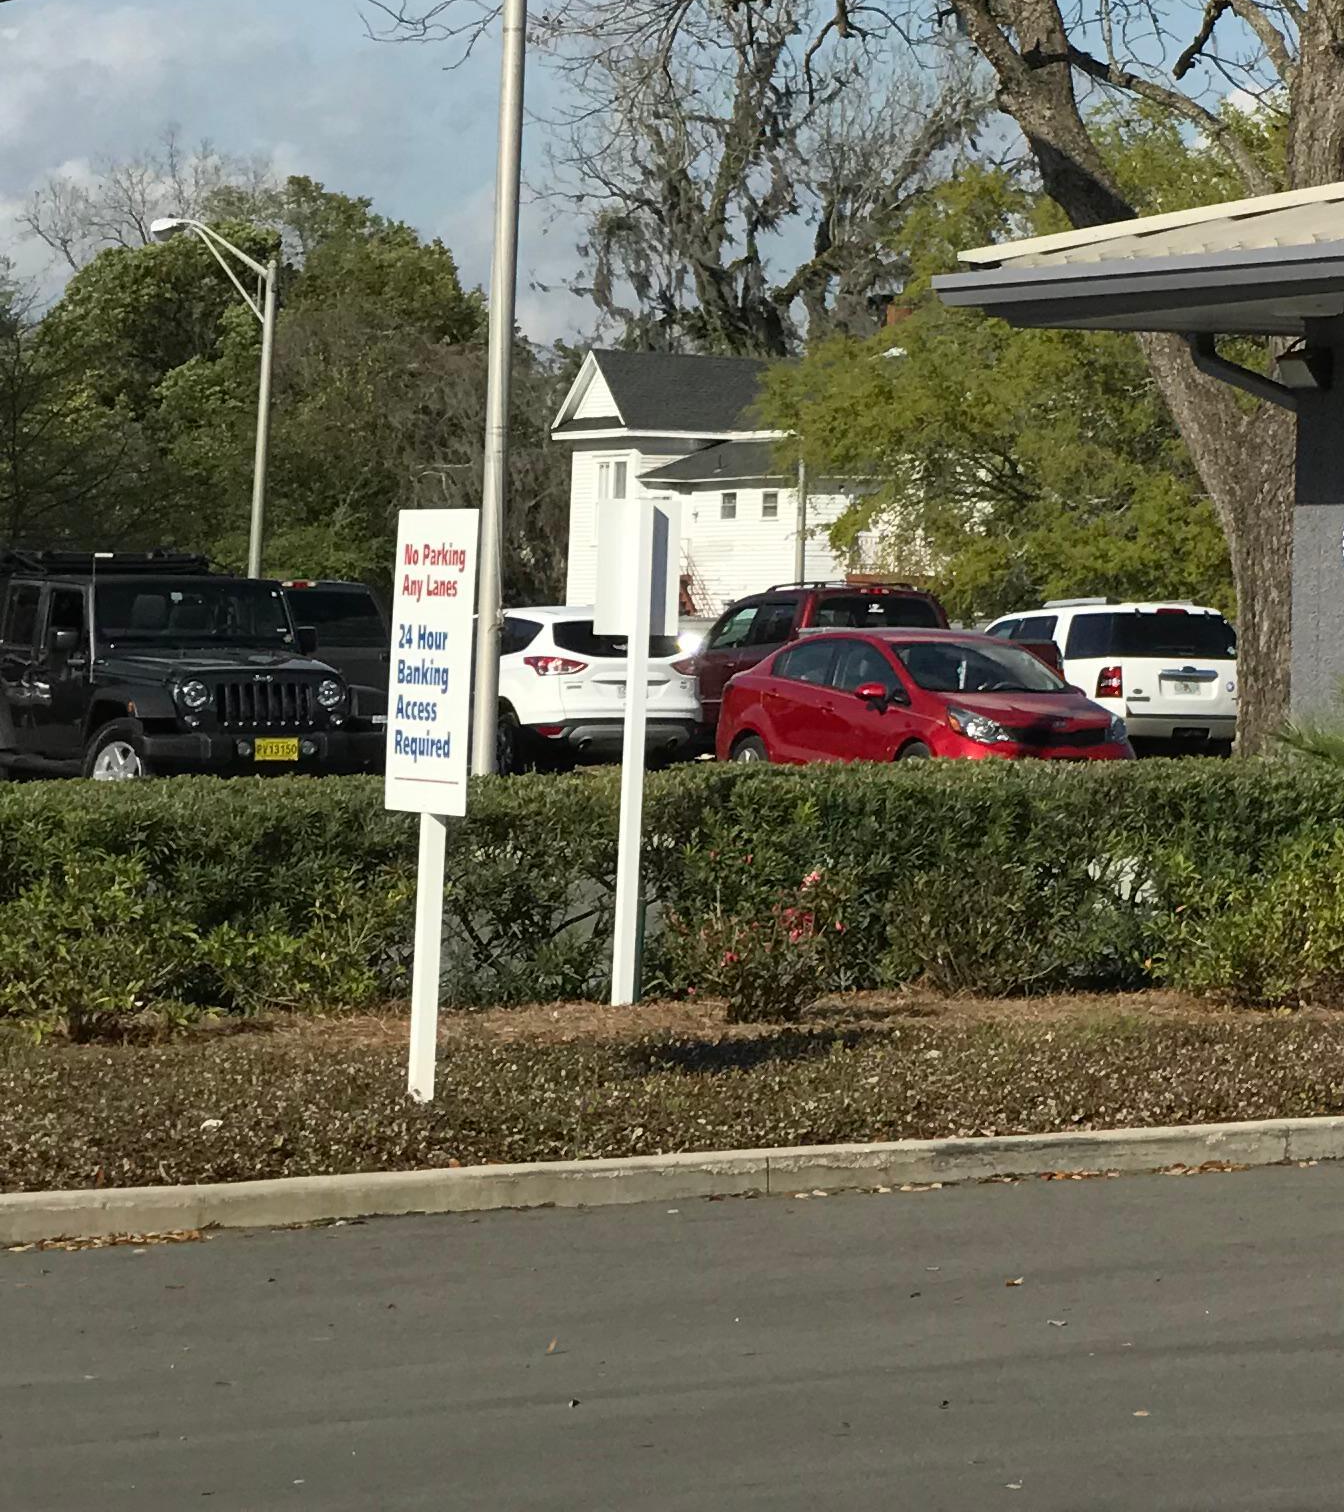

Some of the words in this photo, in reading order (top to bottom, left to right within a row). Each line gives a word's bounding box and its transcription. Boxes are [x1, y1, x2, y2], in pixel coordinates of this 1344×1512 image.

[404, 543, 419, 566] No
[422, 543, 466, 572] Parking
[402, 574, 423, 602] Any
[427, 575, 458, 598] Lanes
[398, 624, 413, 649] 24
[417, 625, 448, 651] Hour
[397, 659, 449, 694] Banking
[395, 694, 437, 722] Access
[394, 729, 451, 763] Required
